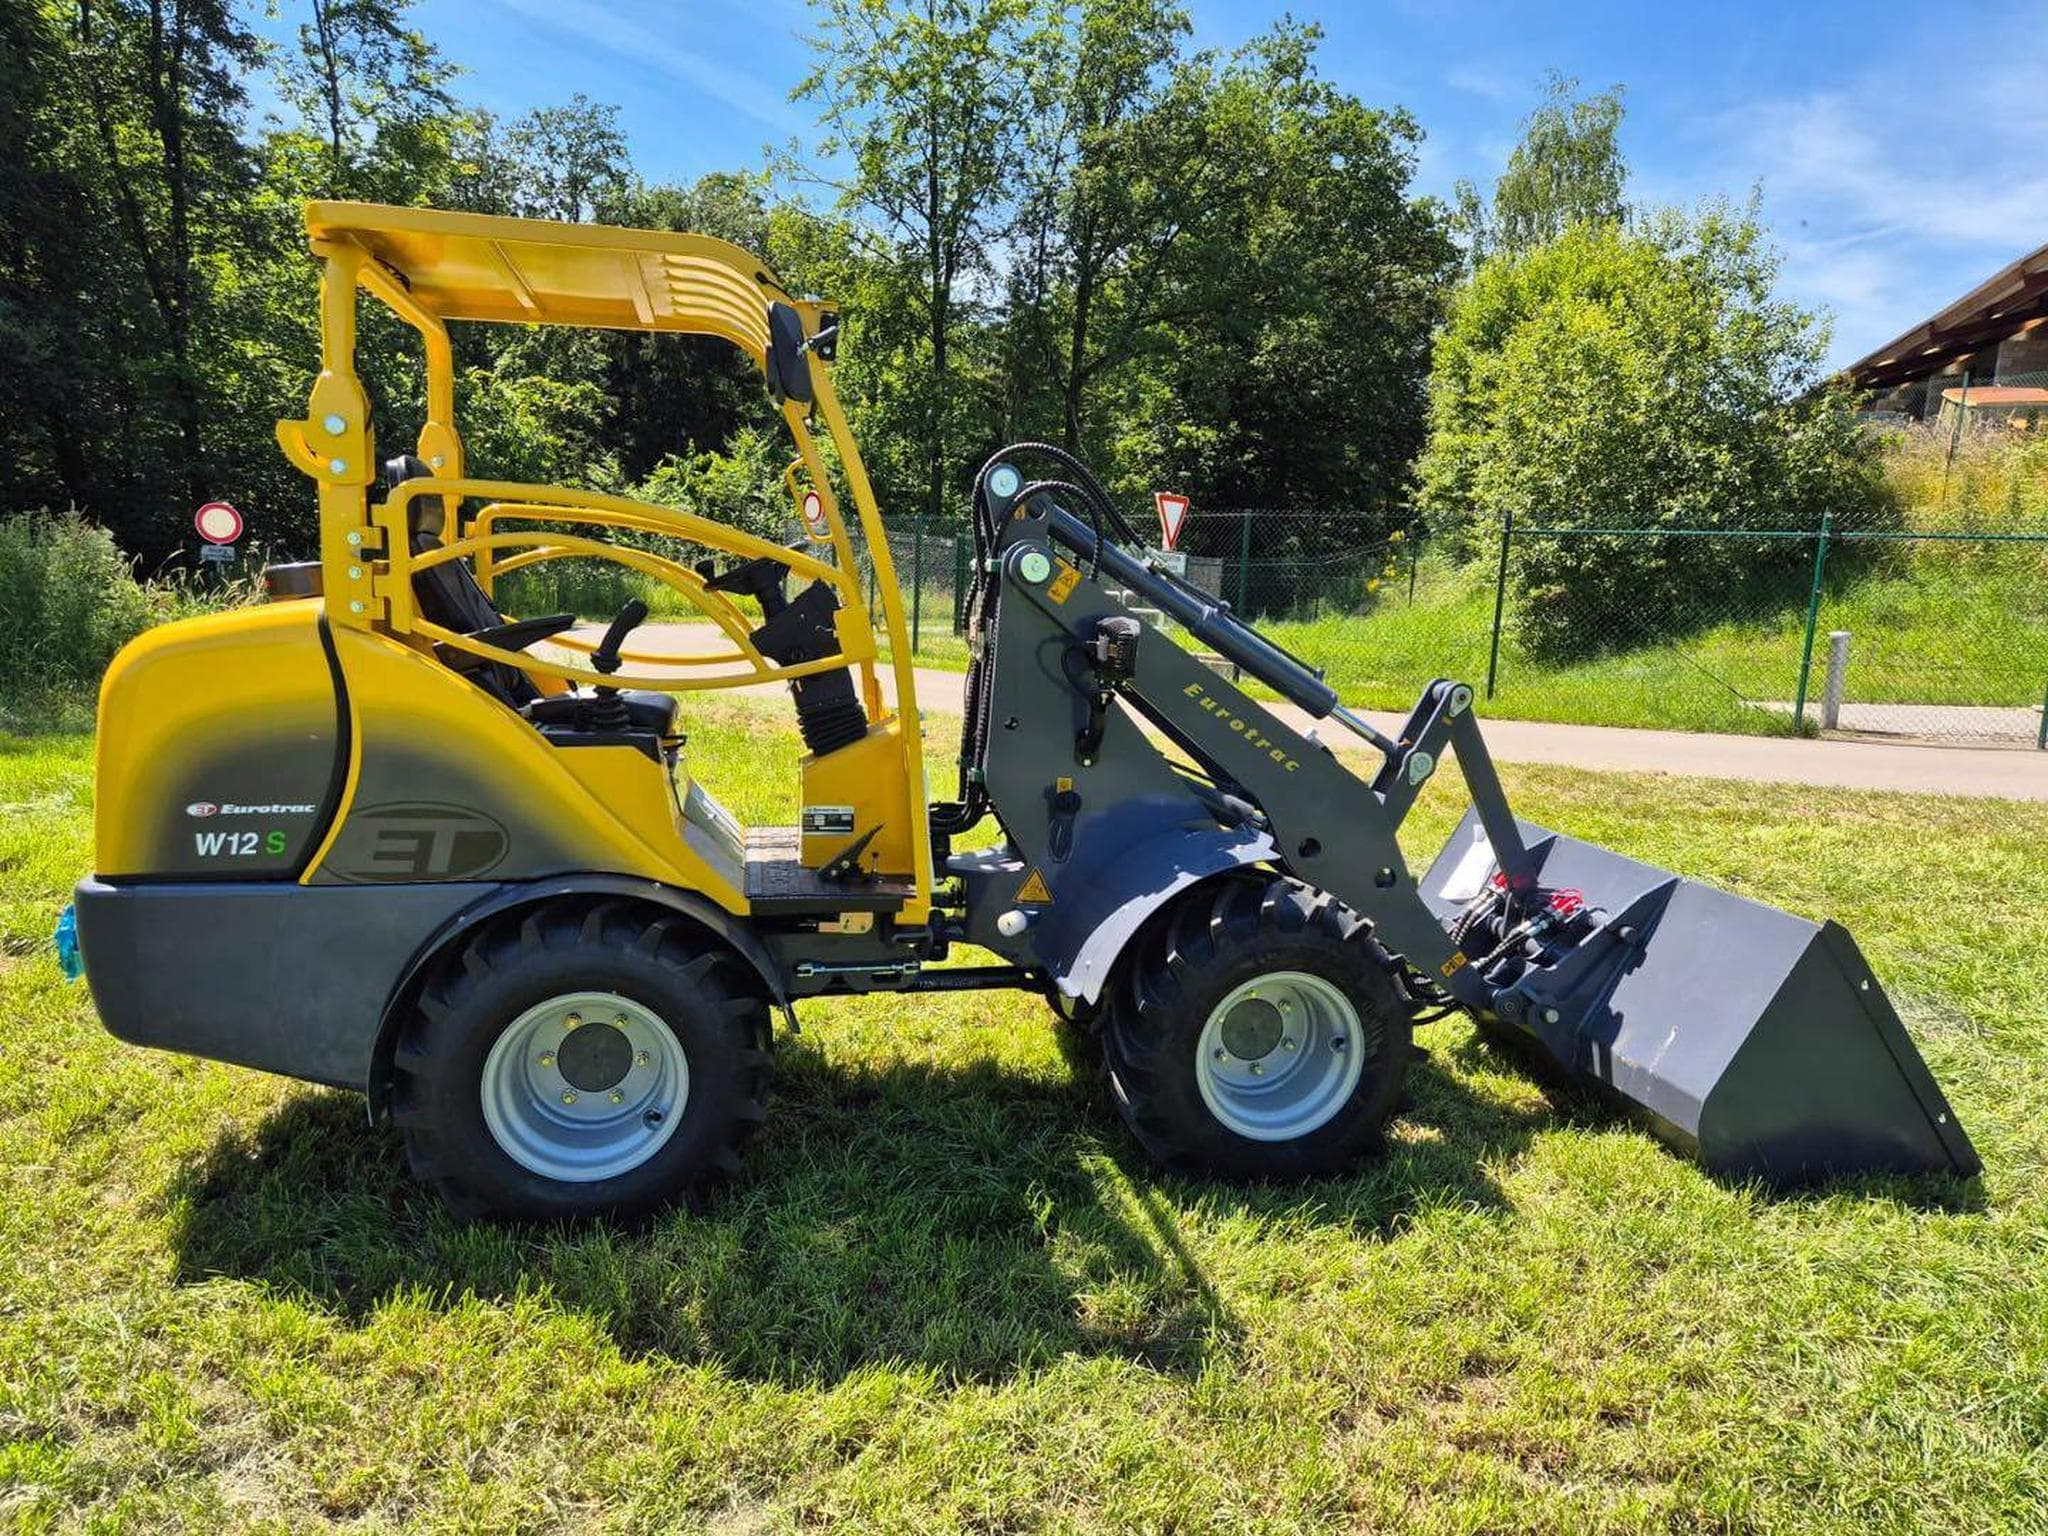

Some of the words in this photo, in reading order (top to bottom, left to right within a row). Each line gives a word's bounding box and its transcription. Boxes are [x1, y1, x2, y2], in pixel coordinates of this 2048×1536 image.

[1183, 682, 1300, 772] Eurotrac
[220, 803, 317, 815] Eurotrac
[195, 831, 259, 857] W12
[265, 831, 286, 854] S
